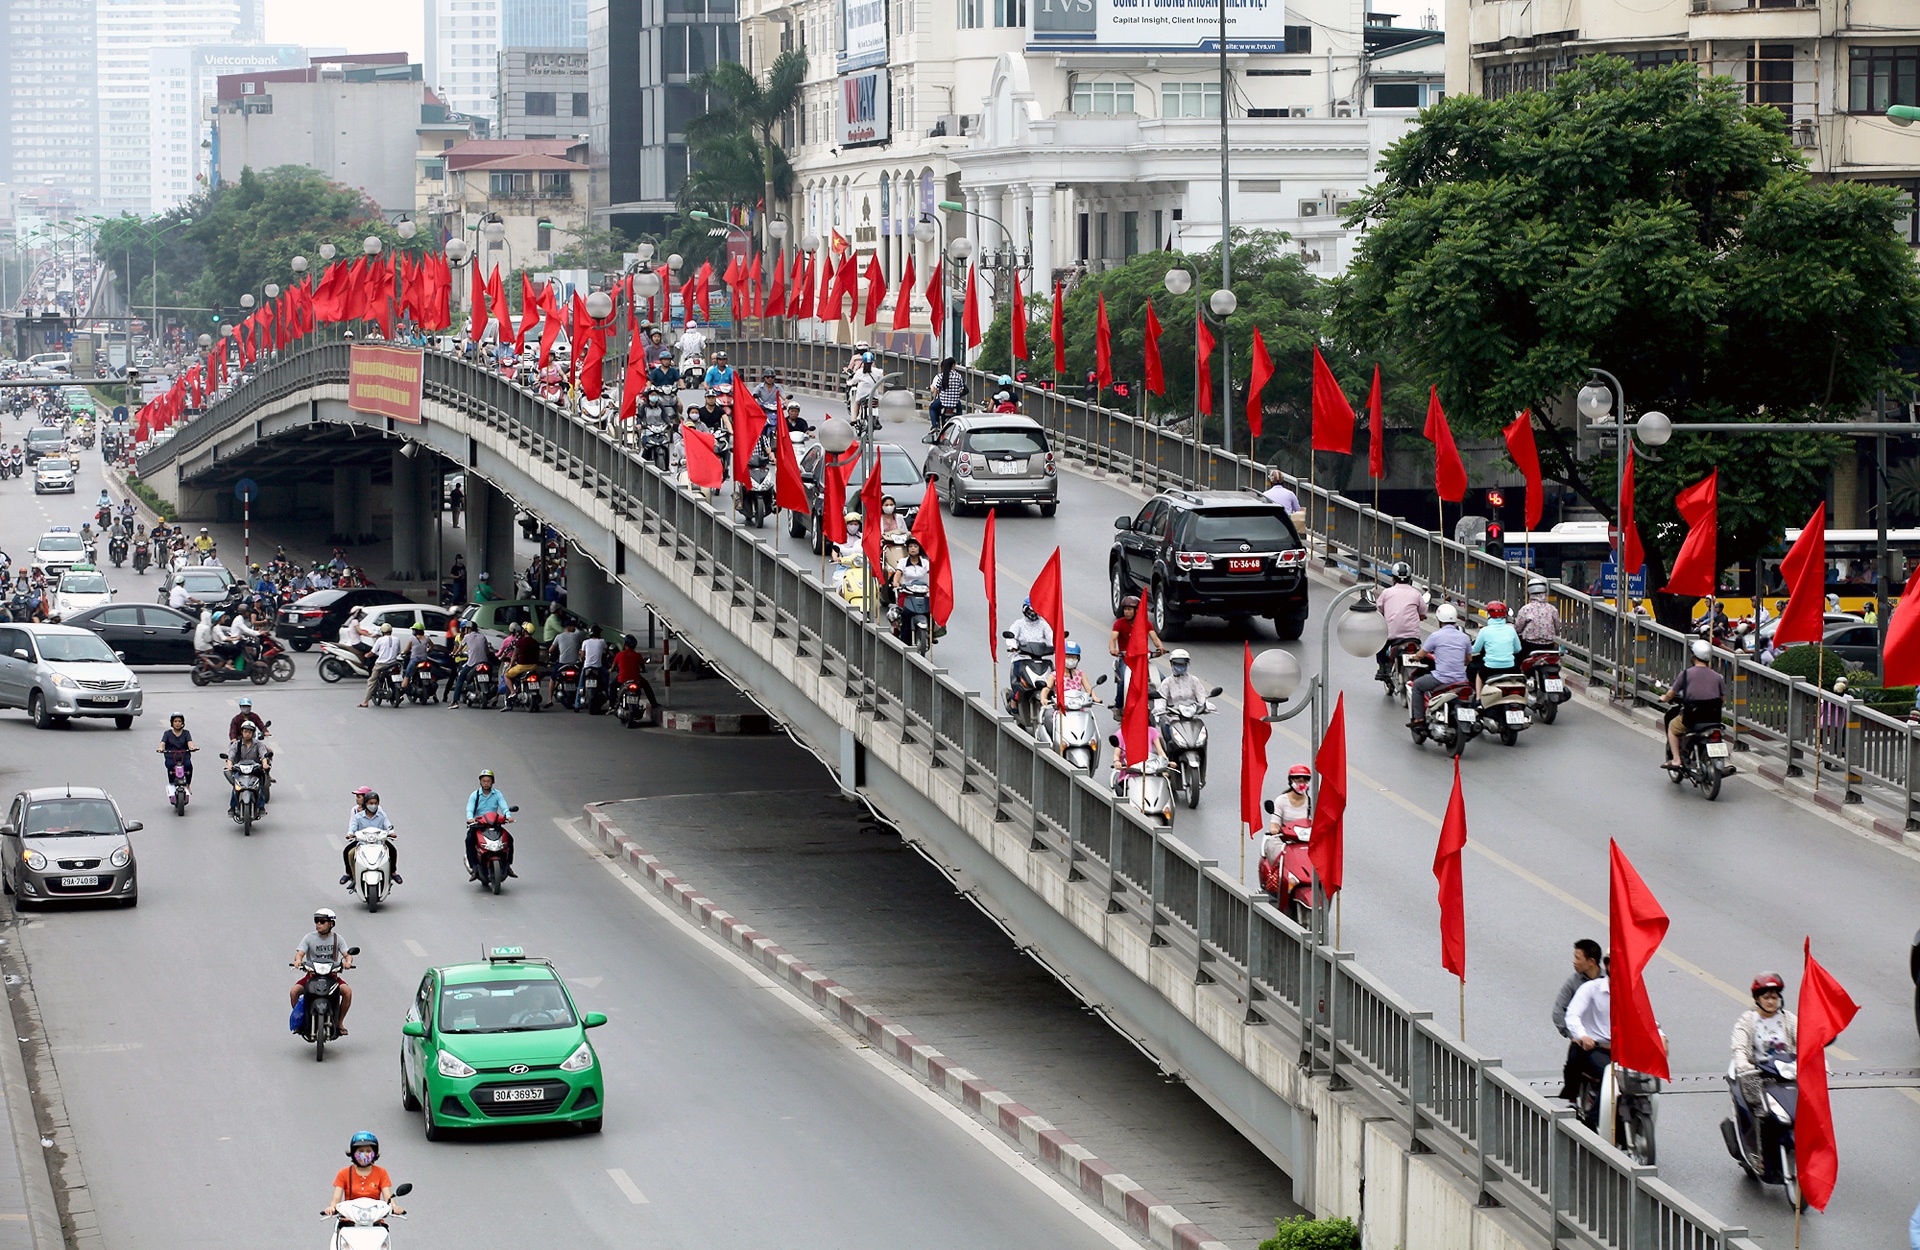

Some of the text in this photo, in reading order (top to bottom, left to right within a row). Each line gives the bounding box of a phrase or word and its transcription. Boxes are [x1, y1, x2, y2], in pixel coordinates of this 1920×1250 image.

[1113, 16, 1237, 26] Capital Insight, Client Innovaion
[204, 54, 278, 65] Vietcombank
[844, 74, 877, 124] VNPAY
[1114, 384, 1128, 396] 46
[1489, 493, 1502, 505] 46
[1229, 559, 1261, 569] TC-36-68
[495, 946, 521, 954] TAXI
